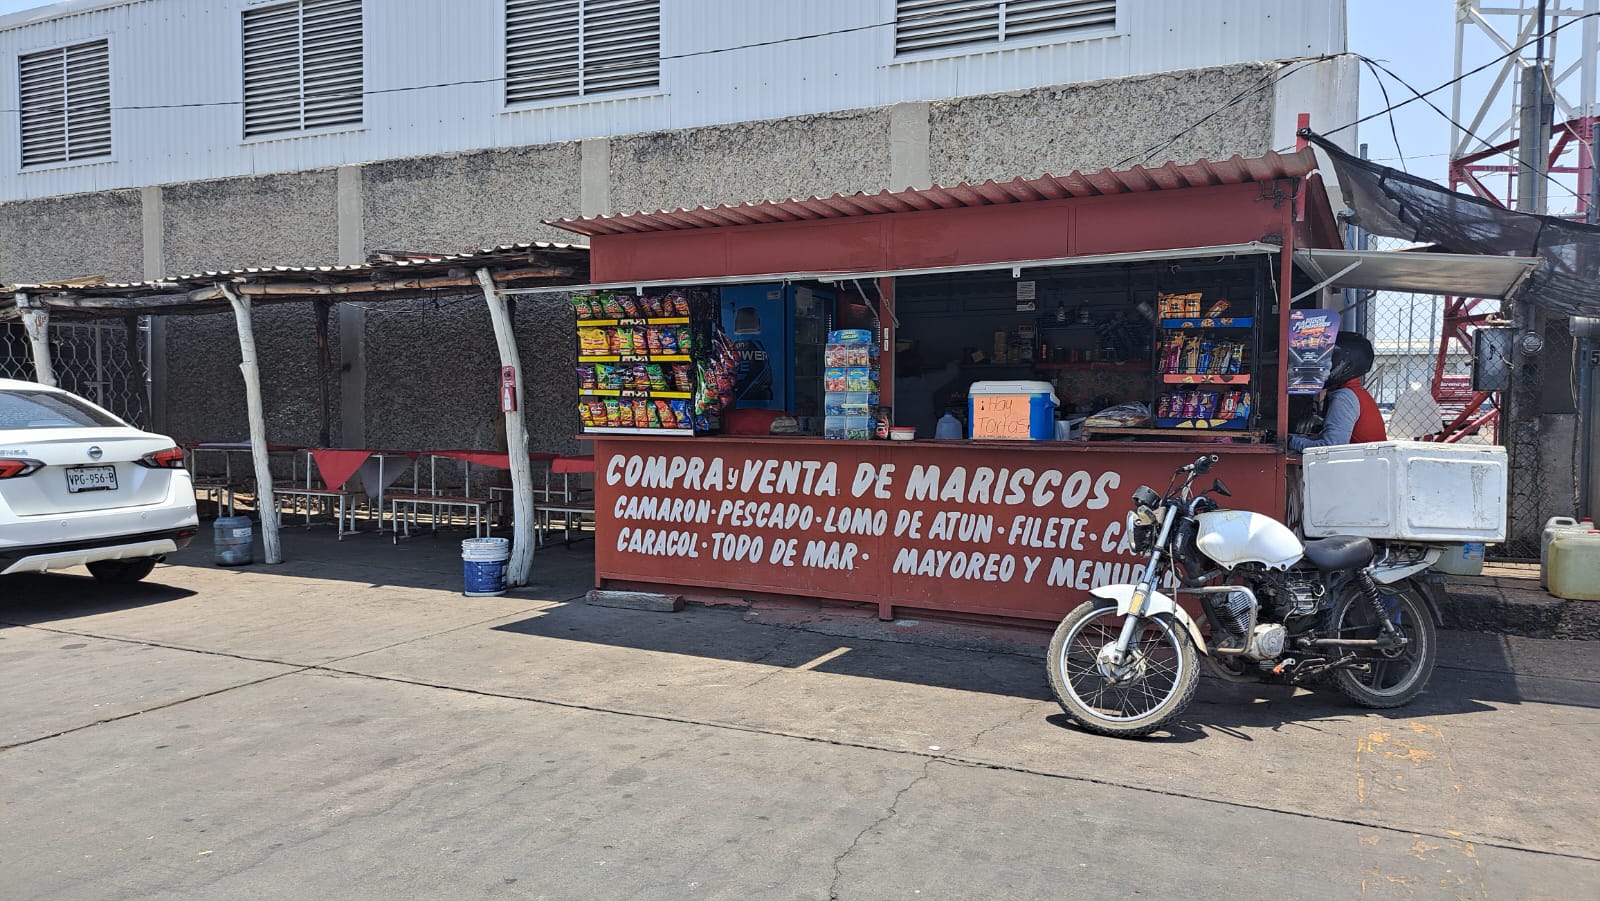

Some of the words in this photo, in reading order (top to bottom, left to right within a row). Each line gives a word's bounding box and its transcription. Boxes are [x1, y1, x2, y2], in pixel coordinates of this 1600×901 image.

[69, 472, 115, 486] VPG-956-B
[607, 455, 724, 492] COMPRA
[741, 460, 838, 497] VENTA
[852, 463, 896, 499] DE
[905, 465, 1121, 510] MARISCOS
[615, 495, 711, 524] CAMARON
[717, 500, 814, 531] PESCADO
[824, 507, 888, 537] LOMO
[894, 510, 924, 540] DE
[929, 511, 994, 544] ATUN
[1008, 516, 1089, 551] FILETE
[617, 527, 699, 558] CARACOL
[712, 533, 765, 564] TODO
[770, 539, 799, 567] DE
[803, 540, 858, 571] MAR
[893, 548, 1016, 583] MAYOREO
[1023, 556, 1042, 584] Y
